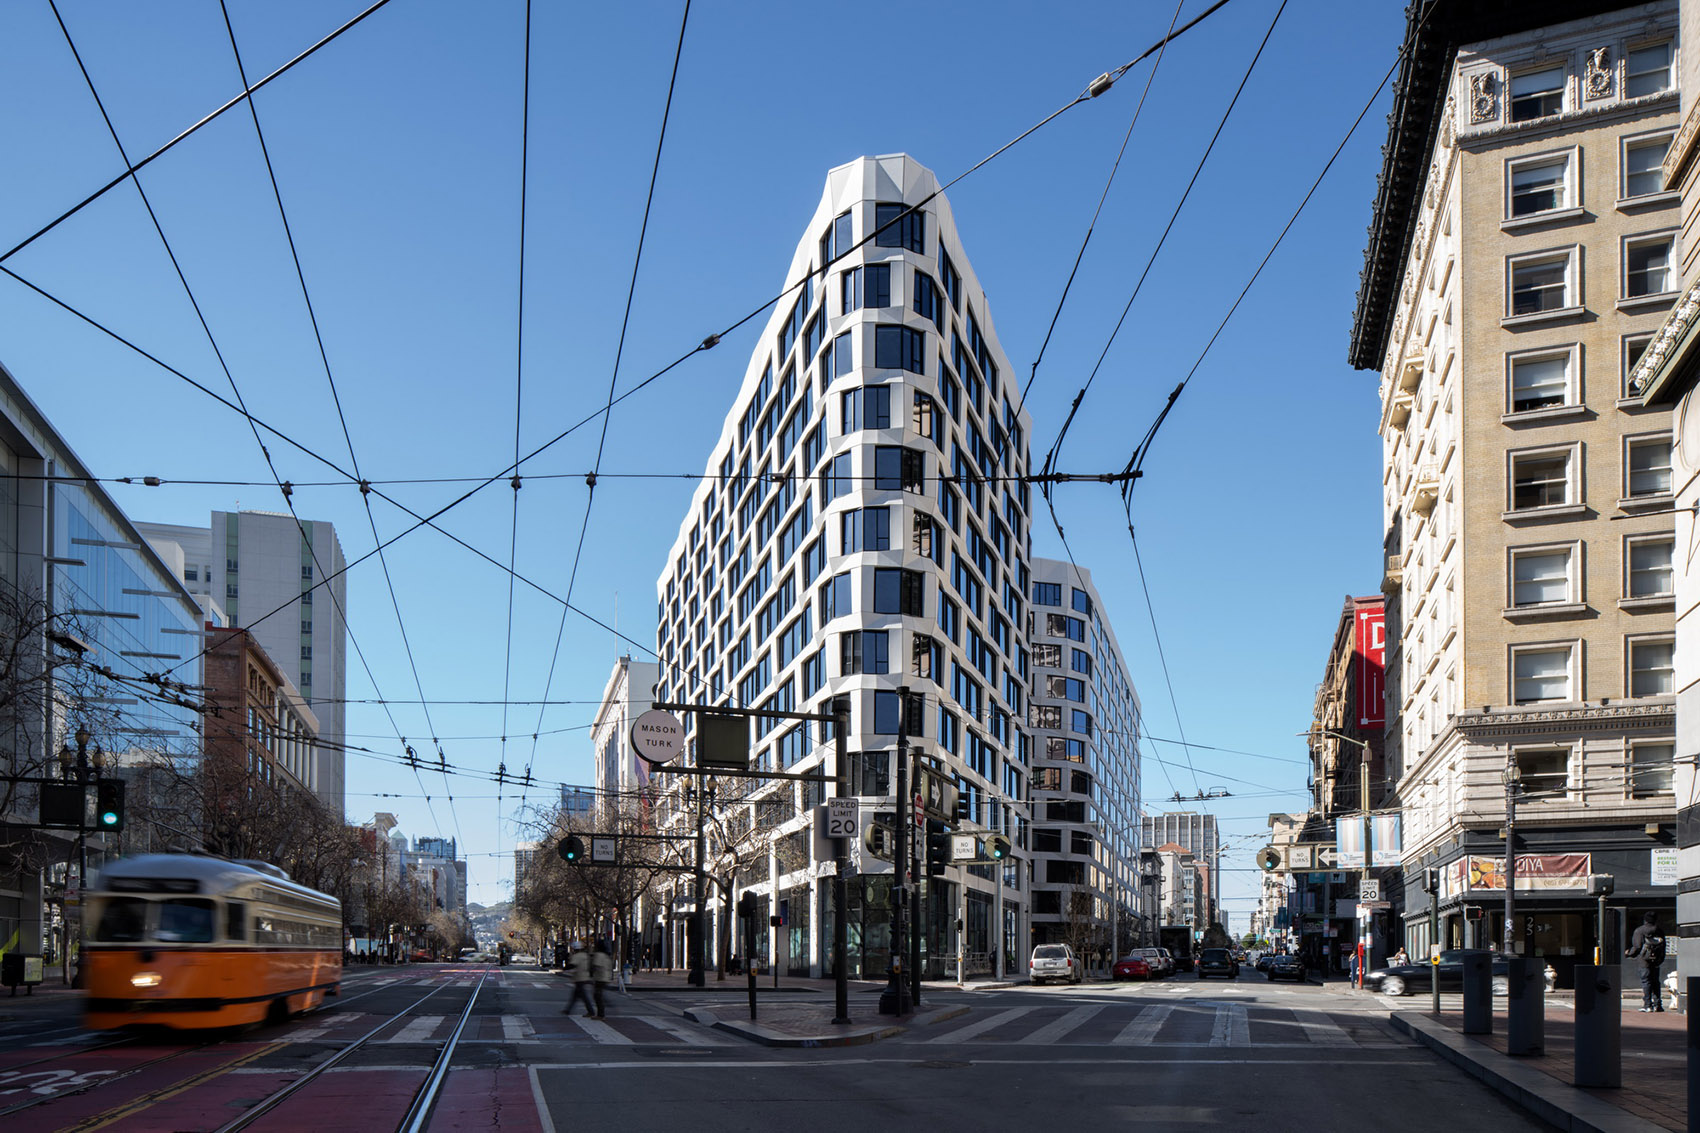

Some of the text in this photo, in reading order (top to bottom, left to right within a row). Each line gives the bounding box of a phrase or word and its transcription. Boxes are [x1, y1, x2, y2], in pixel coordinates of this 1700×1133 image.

[641, 725, 677, 734] MASON
[646, 739, 673, 748] TURK
[830, 801, 856, 809] SPEED
[830, 820, 856, 834] 20
[1516, 858, 1544, 873] DIYA
[1362, 890, 1377, 899] 20
